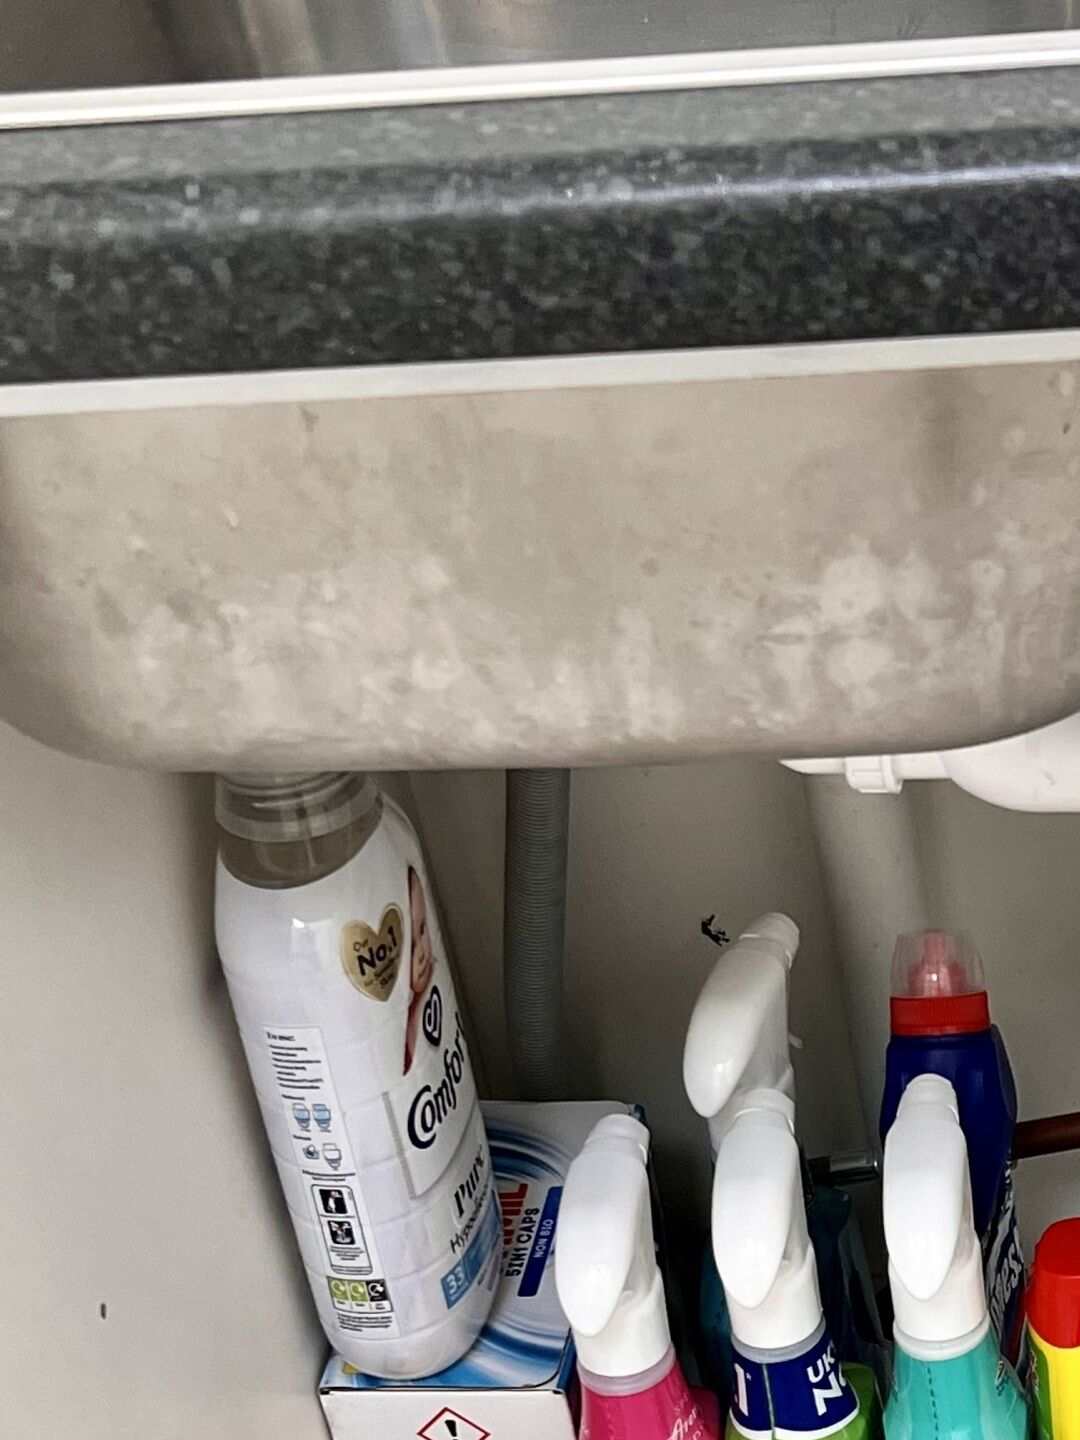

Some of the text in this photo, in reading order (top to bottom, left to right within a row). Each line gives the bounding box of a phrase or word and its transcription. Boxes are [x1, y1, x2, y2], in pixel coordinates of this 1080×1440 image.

[356, 925, 398, 978] No.1
[517, 1206, 540, 1246] CAPS
[532, 1218, 555, 1260] NON BIO
[447, 1264, 465, 1295] 33
